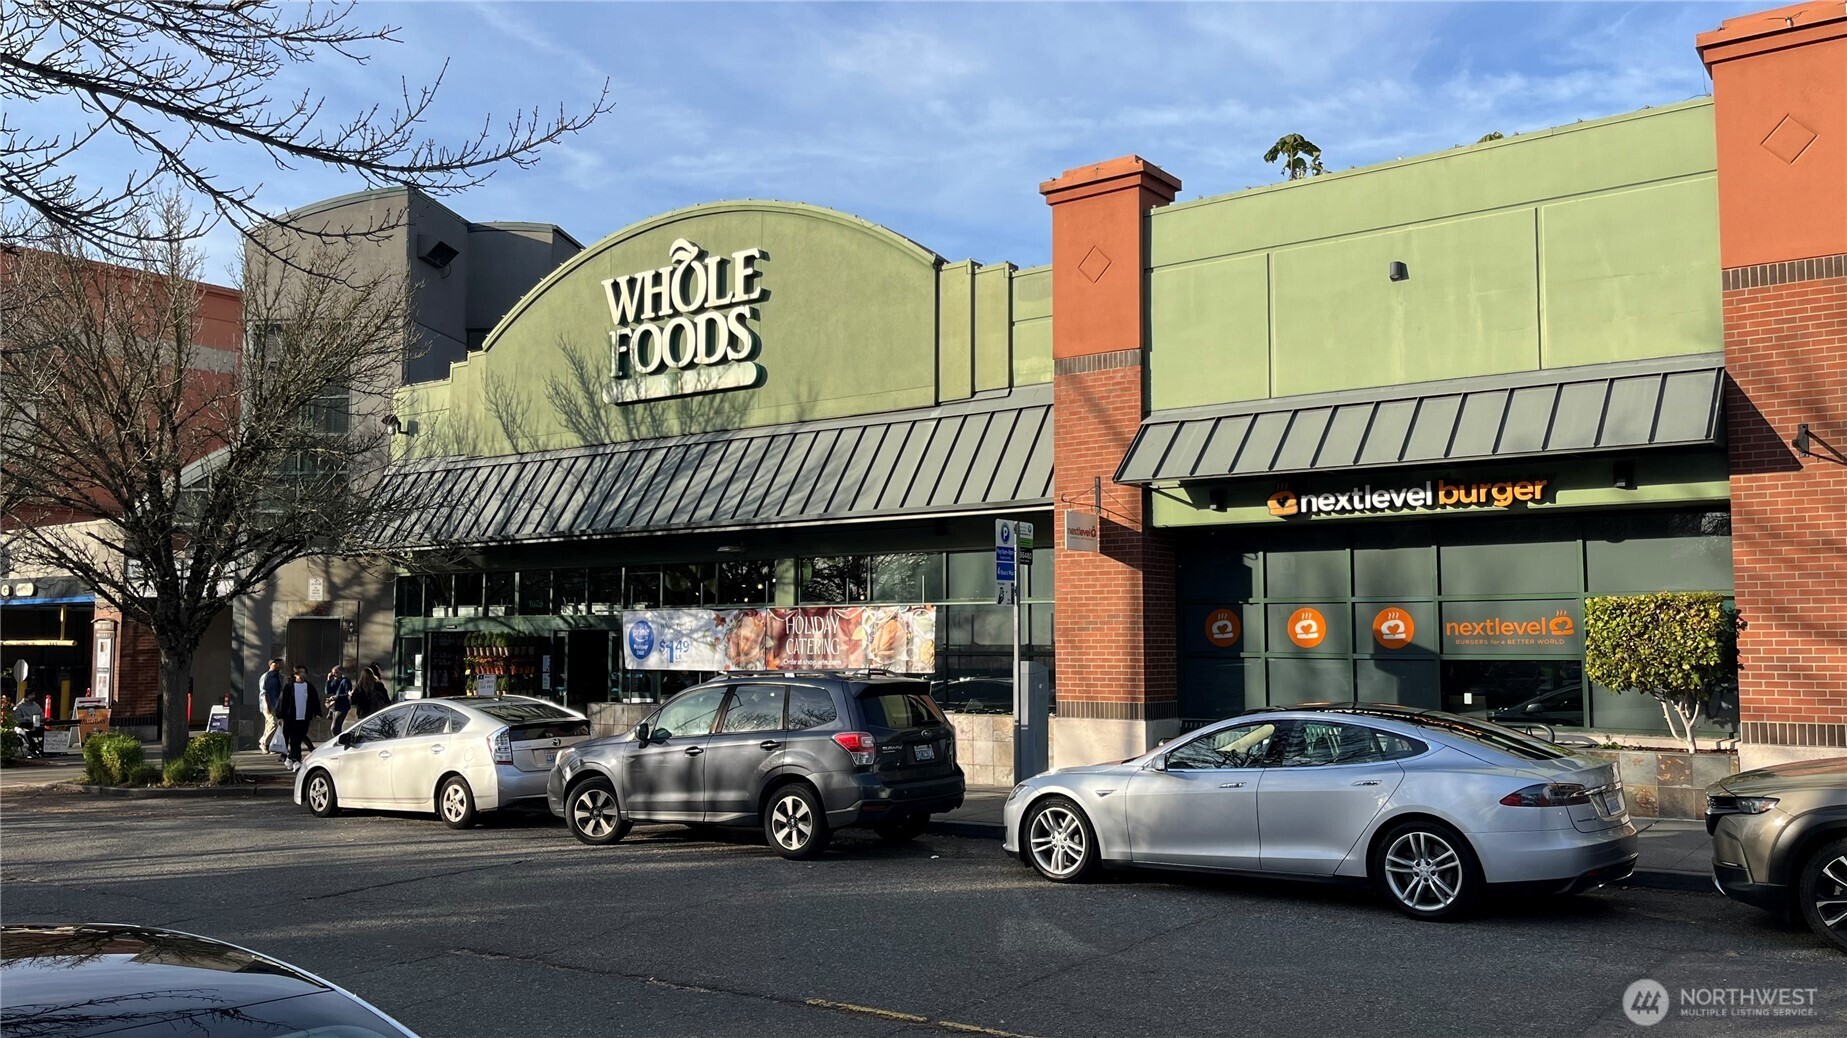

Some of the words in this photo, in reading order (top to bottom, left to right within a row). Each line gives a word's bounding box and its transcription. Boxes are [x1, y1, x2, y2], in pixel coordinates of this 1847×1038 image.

[601, 238, 761, 325] WHOLE
[609, 305, 752, 377] FOODS
[1301, 480, 1432, 512] nextlevel
[1438, 480, 1547, 506] burger
[785, 615, 840, 635] HOLIDAY
[1446, 617, 1546, 636] nextlevel
[785, 638, 840, 655] CATERING
